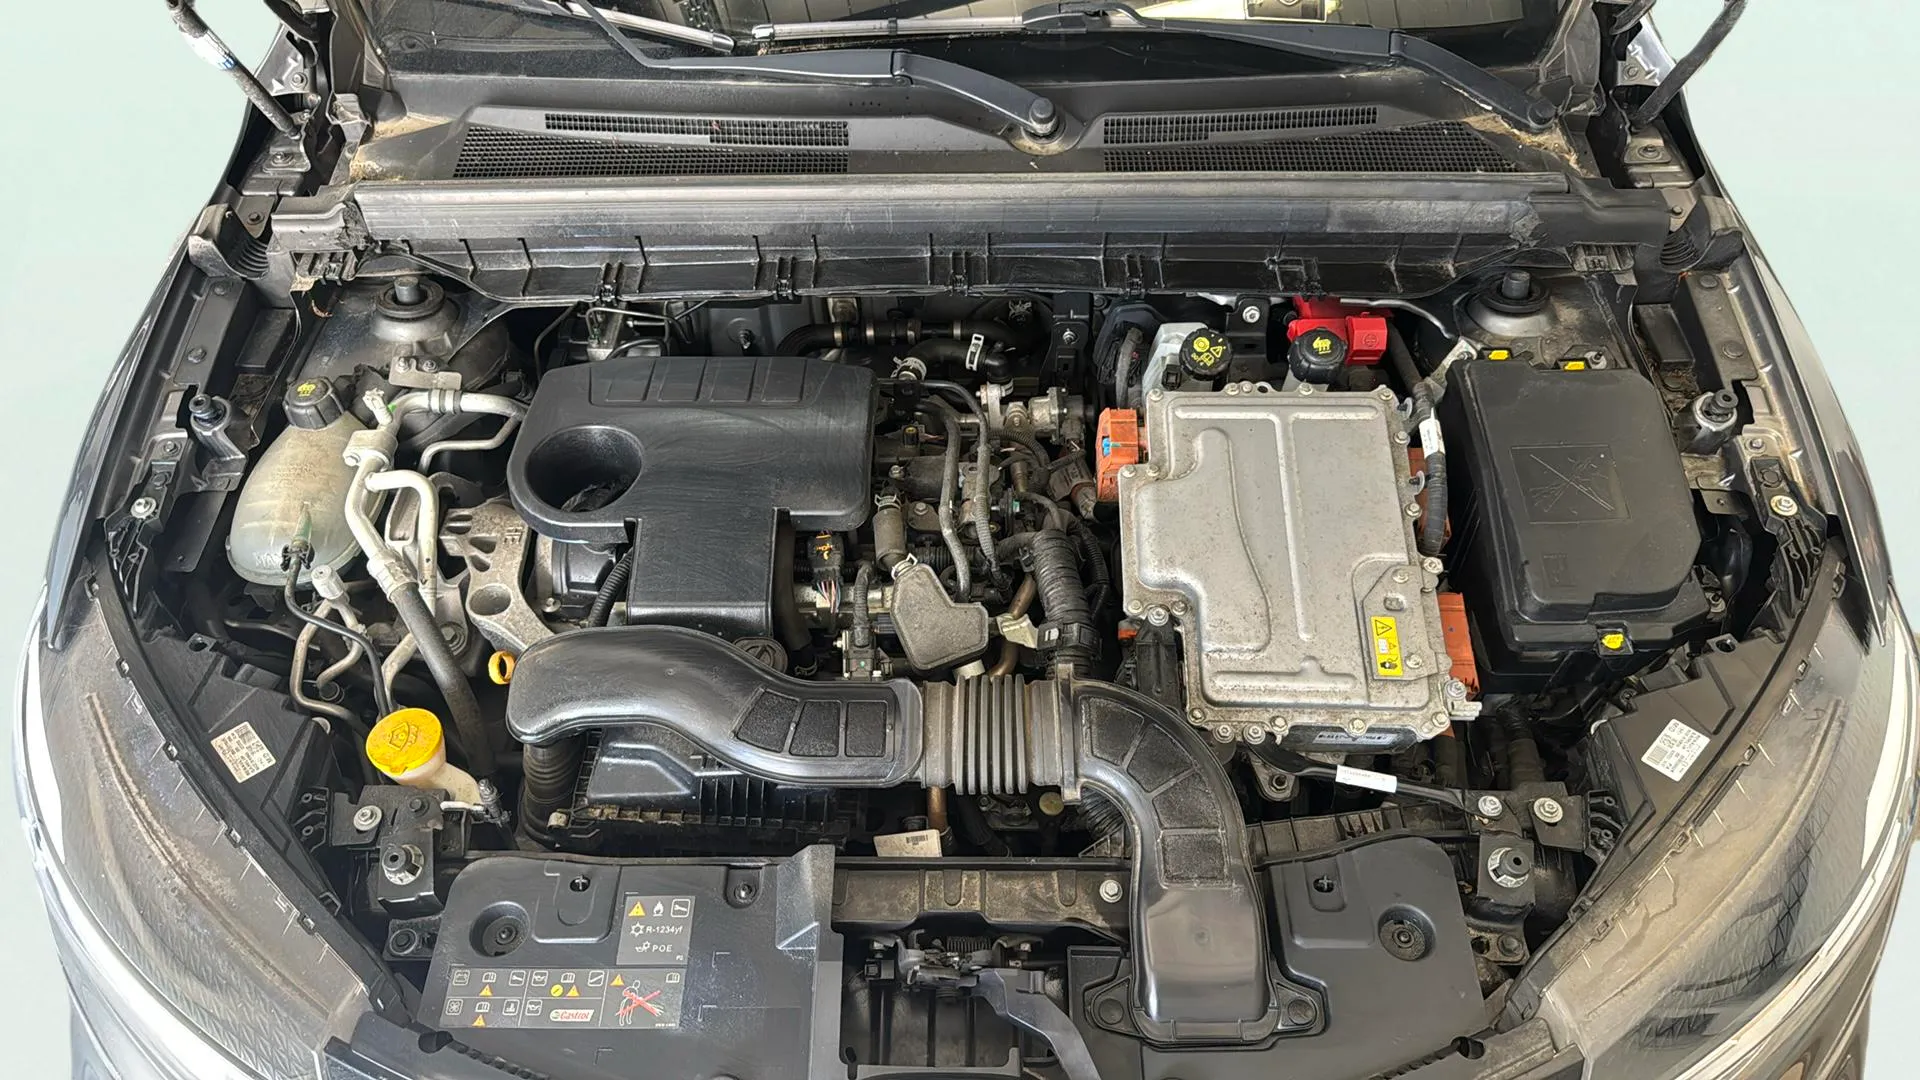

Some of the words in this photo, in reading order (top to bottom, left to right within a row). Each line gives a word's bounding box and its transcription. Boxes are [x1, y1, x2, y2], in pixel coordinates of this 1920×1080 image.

[646, 926, 683, 935] R-1234yf
[652, 944, 673, 952] POE
[560, 1010, 590, 1020] Castrol
